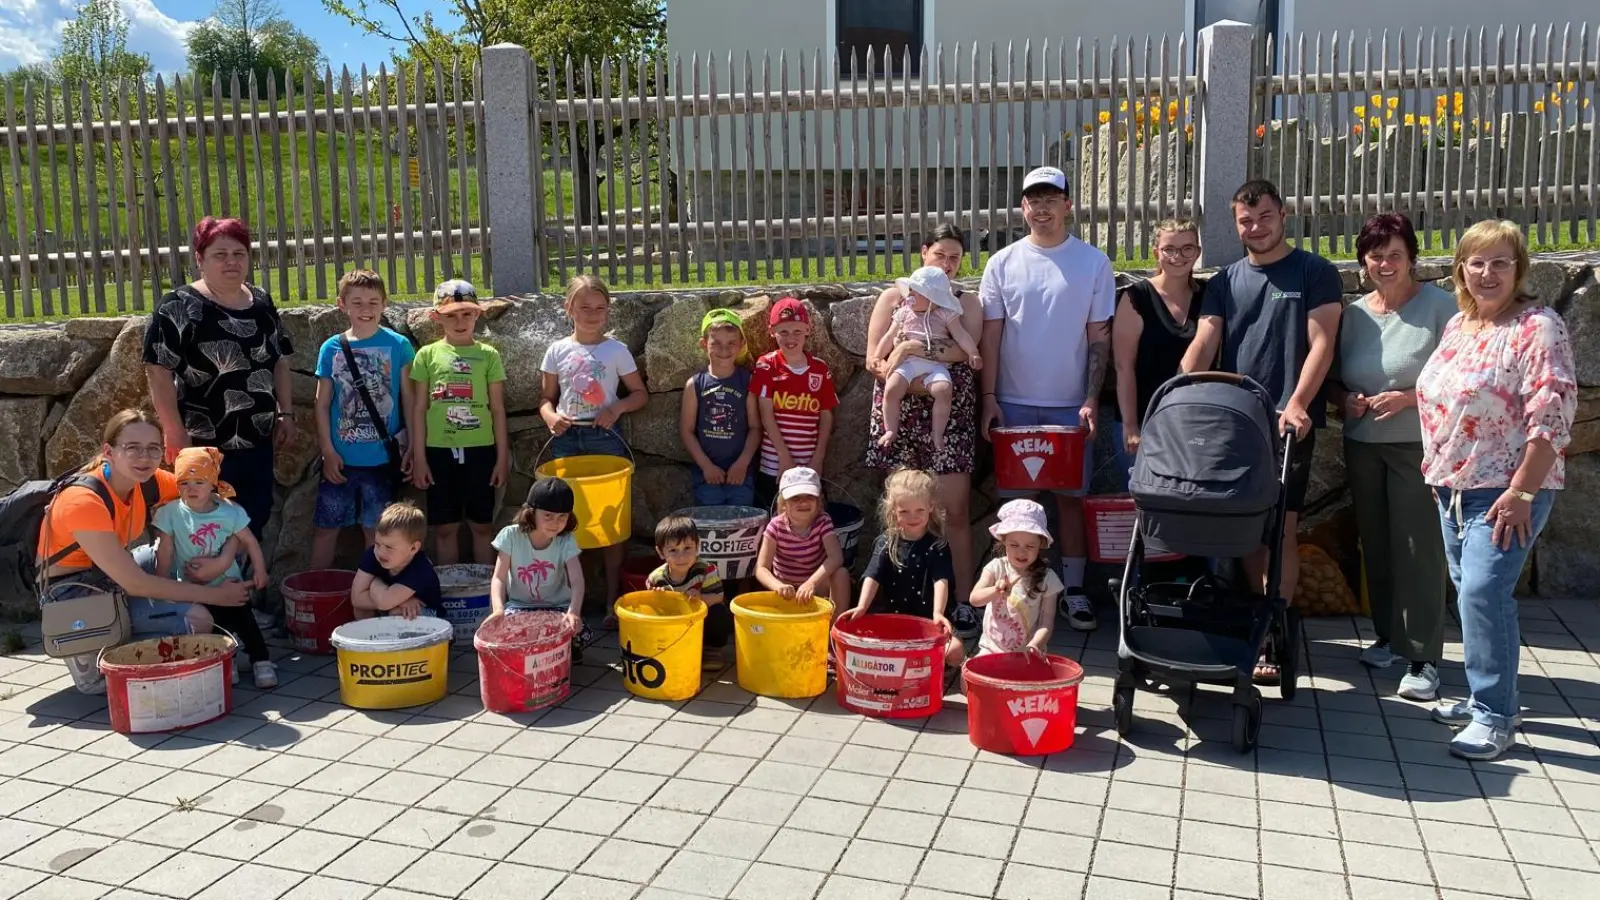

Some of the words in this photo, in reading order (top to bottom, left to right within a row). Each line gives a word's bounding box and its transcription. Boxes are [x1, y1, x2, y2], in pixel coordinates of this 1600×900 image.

[773, 391, 820, 413] Netto
[1011, 438, 1054, 456] KEIM
[700, 538, 754, 553] ROFITEC
[442, 600, 467, 608] axit
[350, 661, 428, 678] PROFITEC
[620, 640, 666, 689] to
[1007, 693, 1060, 717] KEIM
